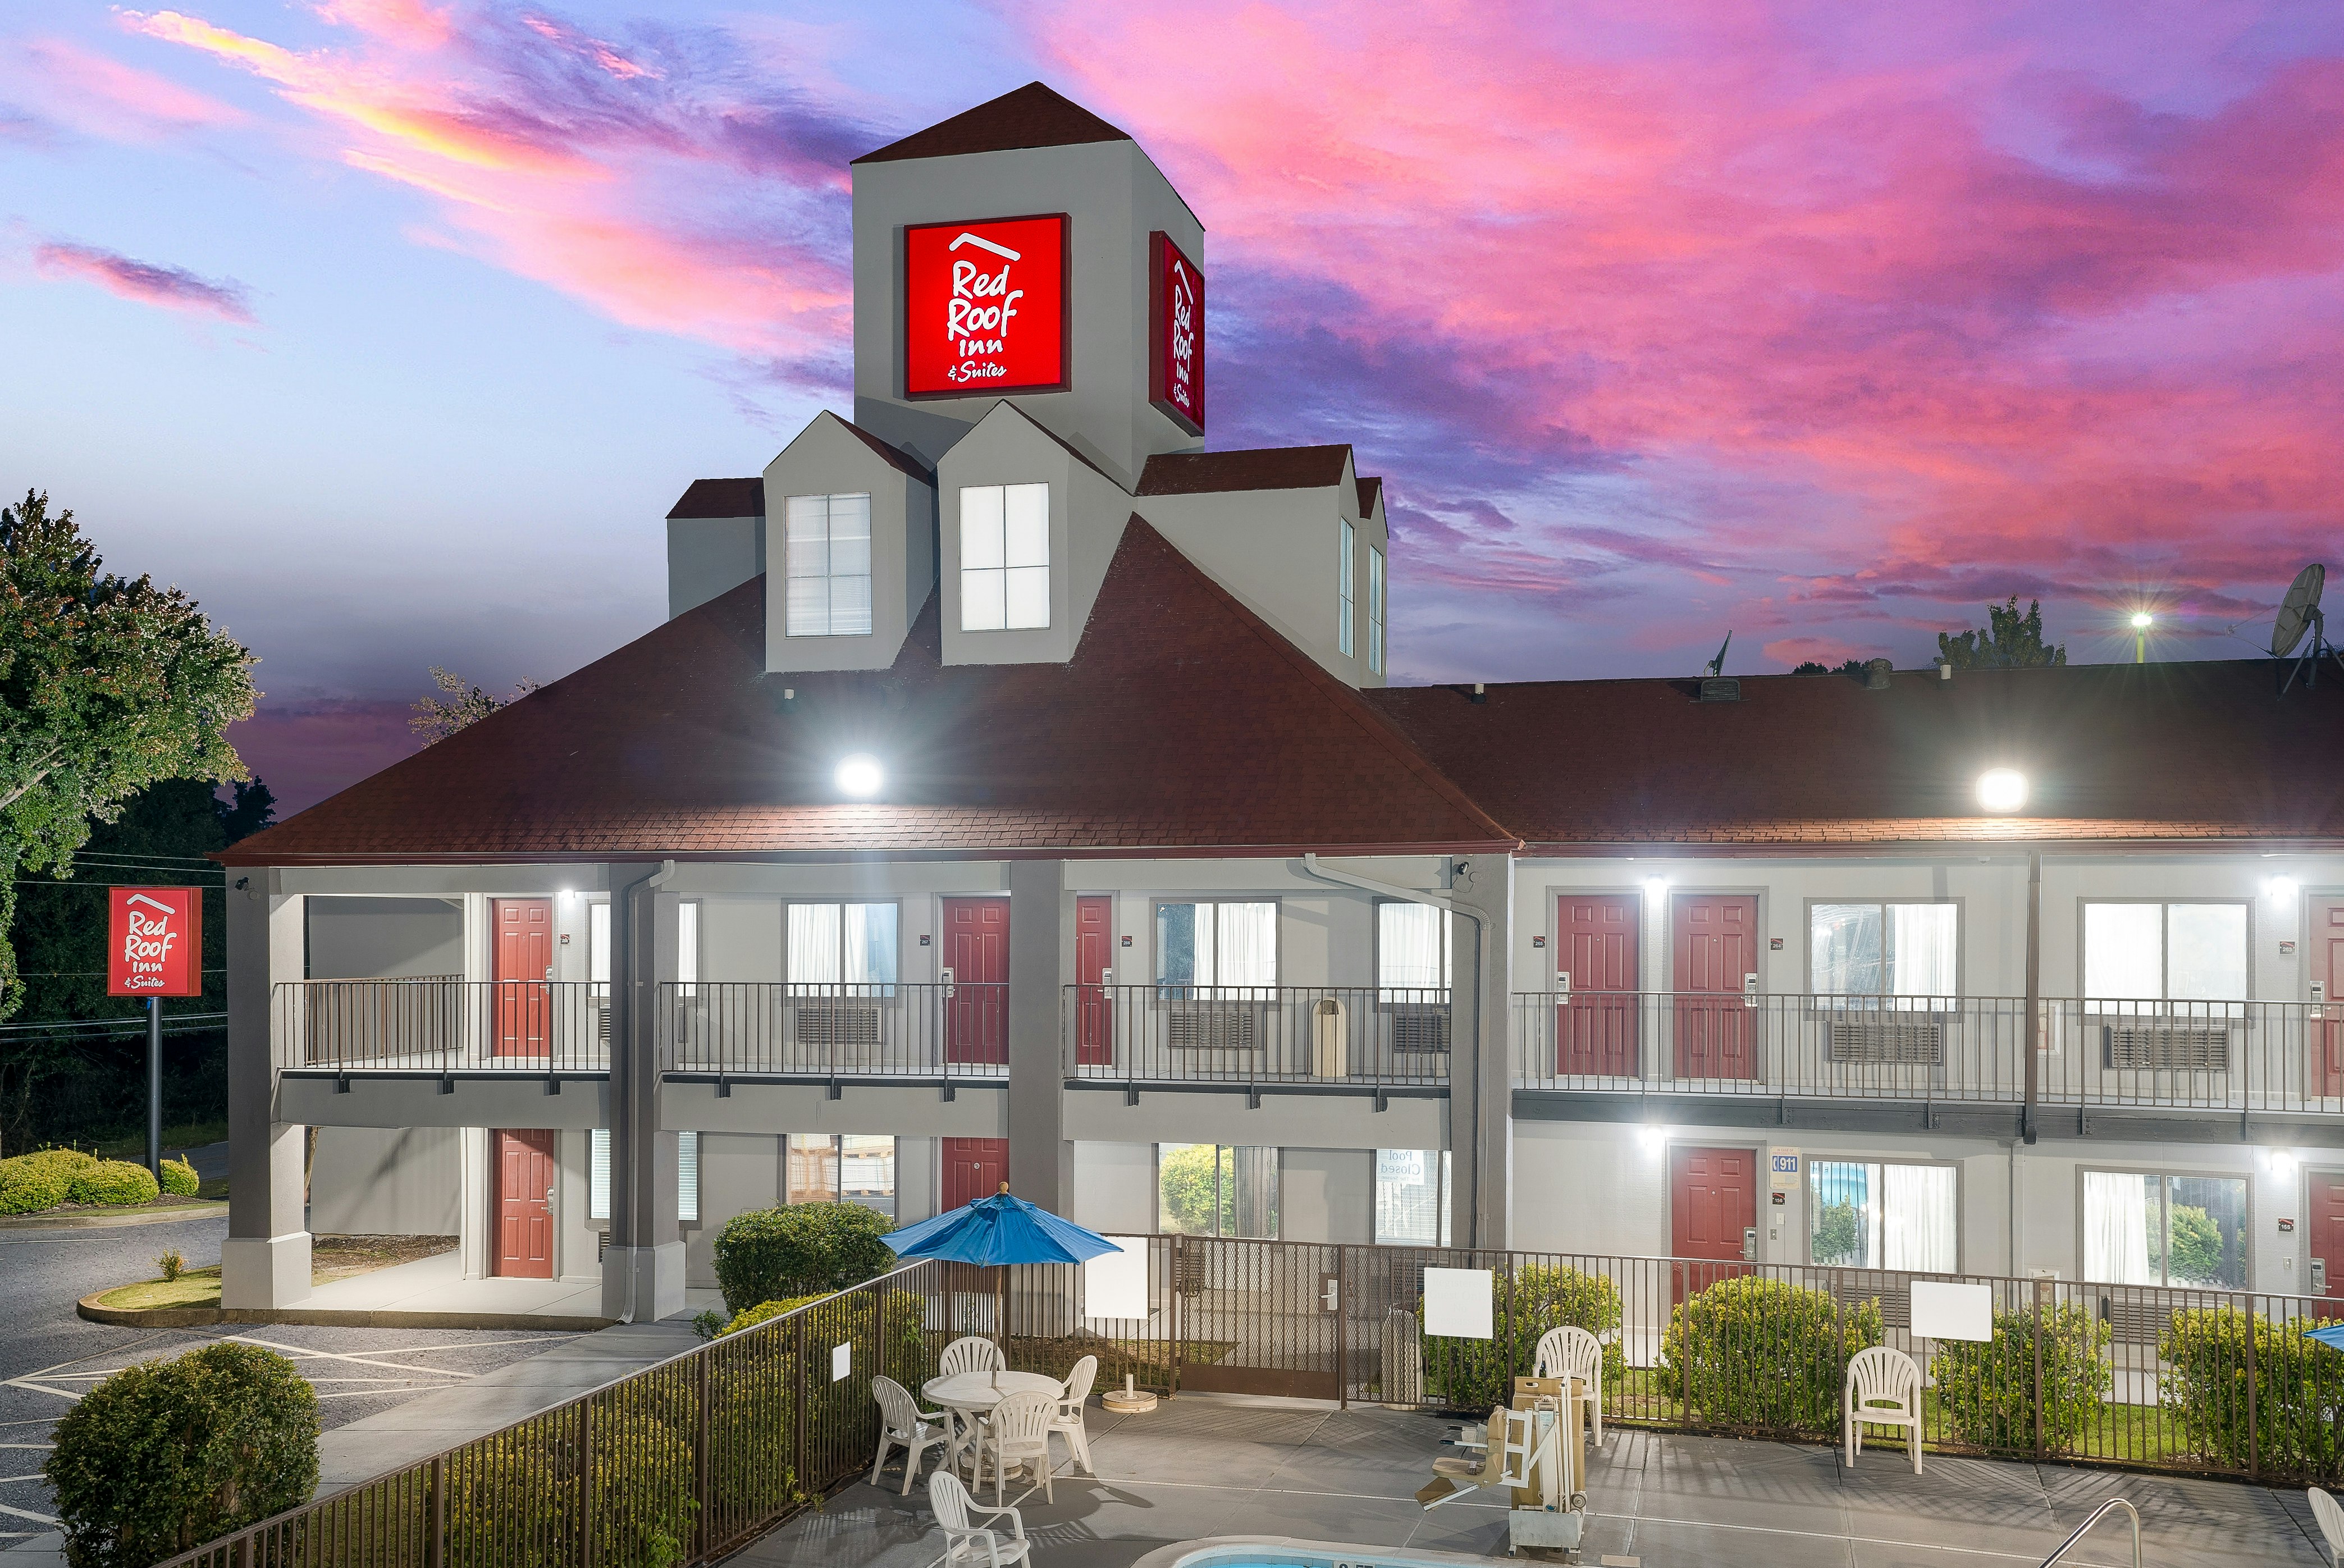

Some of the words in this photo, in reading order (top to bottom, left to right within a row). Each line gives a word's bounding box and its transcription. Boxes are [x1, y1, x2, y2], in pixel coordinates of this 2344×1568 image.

[953, 260, 1010, 299] Red
[947, 290, 1023, 341] Roof
[1175, 285, 1191, 332] Red
[1173, 319, 1194, 372] Roof
[129, 911, 168, 937] Red
[124, 932, 177, 962] Roof
[1780, 1157, 1795, 1171] 911
